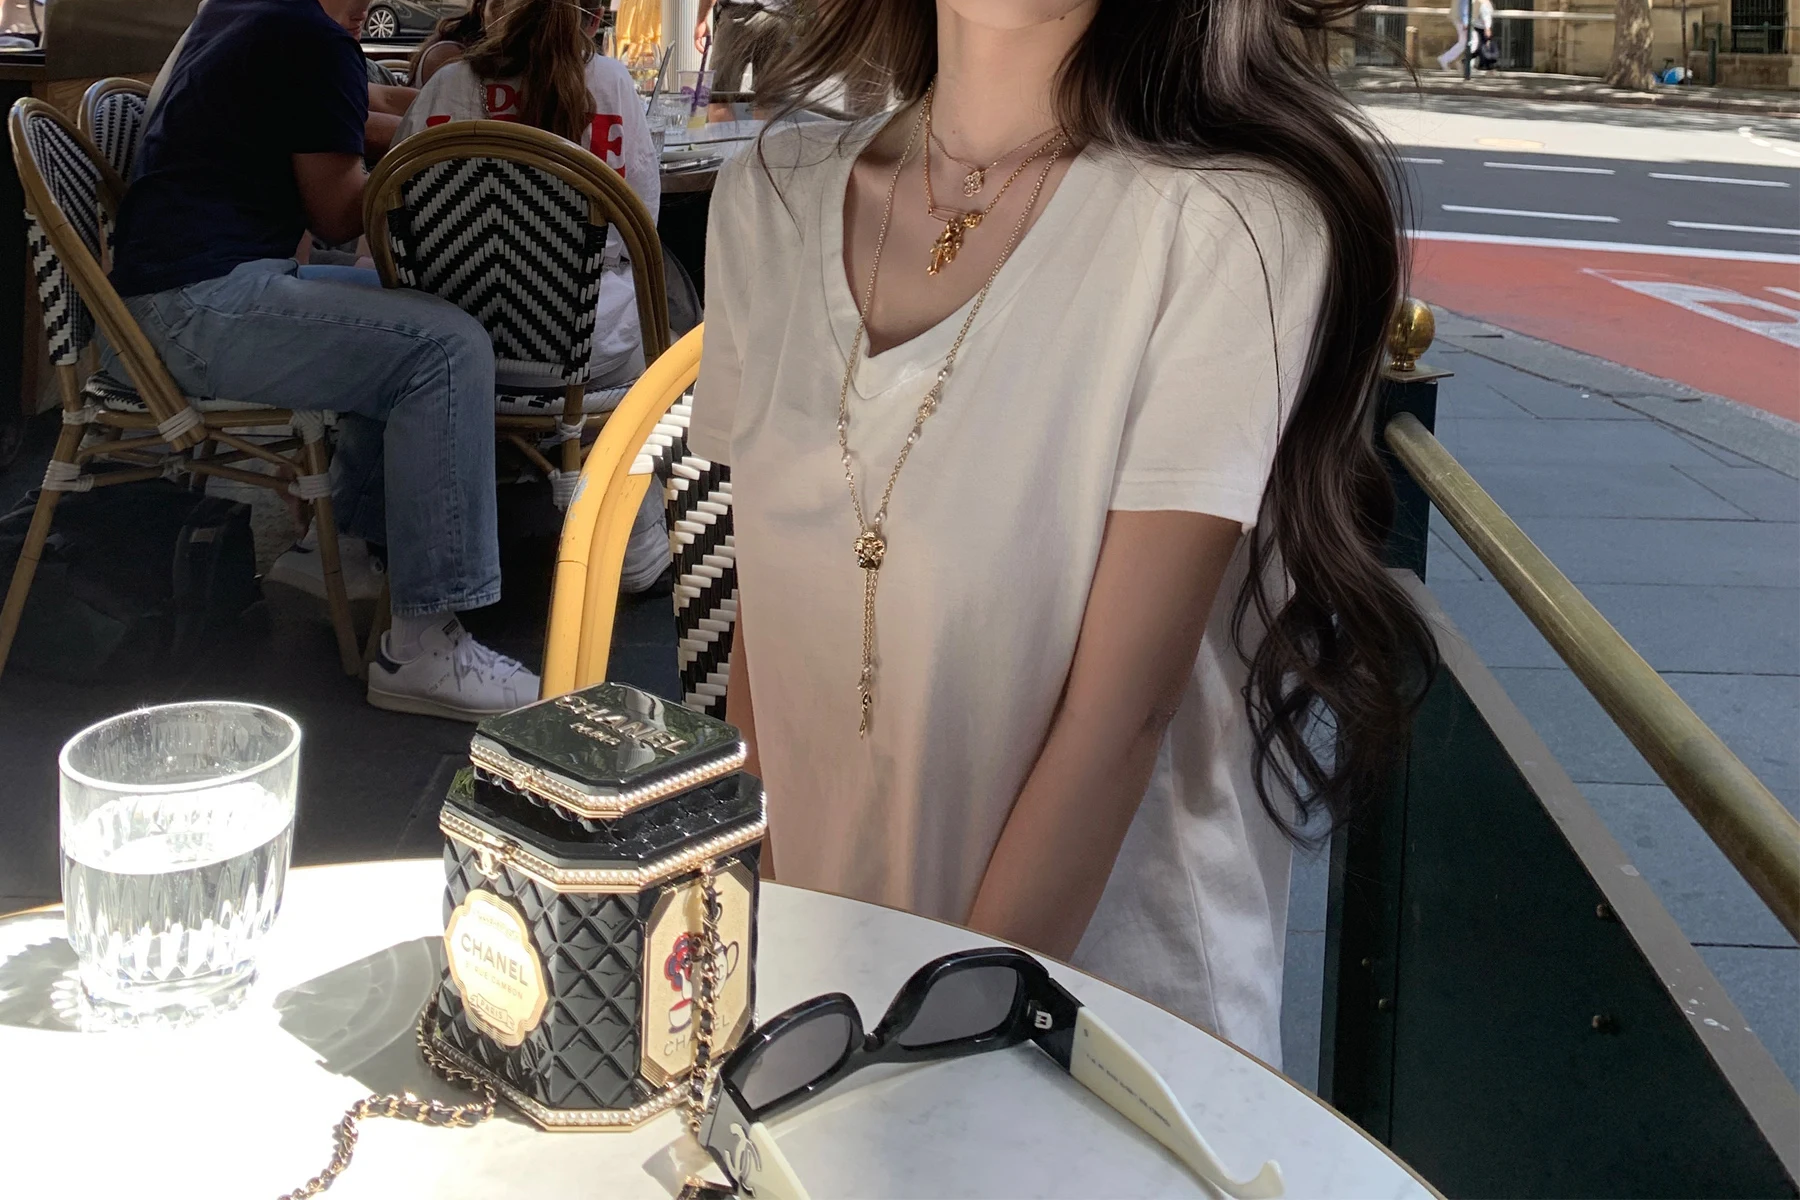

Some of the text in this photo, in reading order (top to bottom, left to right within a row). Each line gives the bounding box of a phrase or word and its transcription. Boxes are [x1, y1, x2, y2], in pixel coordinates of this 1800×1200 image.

[555, 696, 687, 755] CHANEL
[461, 933, 528, 987] CHANEL
[491, 976, 523, 1000] CAMBON
[480, 1001, 503, 1019] PARIS
[664, 1014, 730, 1057] CHAEL
